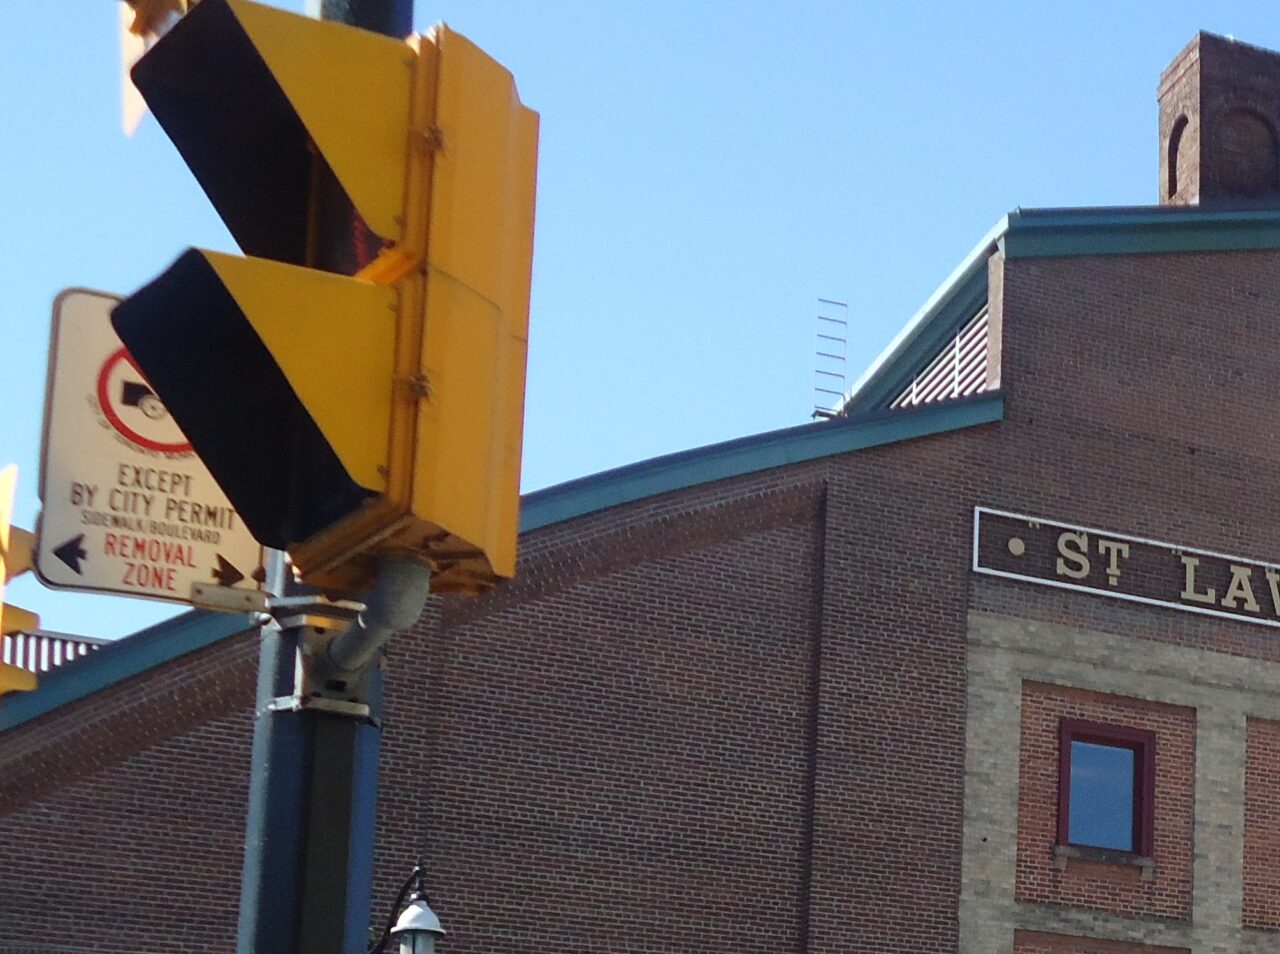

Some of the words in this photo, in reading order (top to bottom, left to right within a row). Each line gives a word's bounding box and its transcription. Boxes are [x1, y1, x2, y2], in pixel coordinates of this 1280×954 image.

[117, 462, 194, 497] EXCEPT
[70, 481, 98, 507] BY
[108, 488, 155, 516] CITY
[165, 497, 238, 530] PERMIT
[103, 532, 197, 569] REMOVAL
[149, 520, 221, 545] BOULEVARD
[122, 562, 178, 591] ZONE
[1055, 531, 1130, 587] ST
